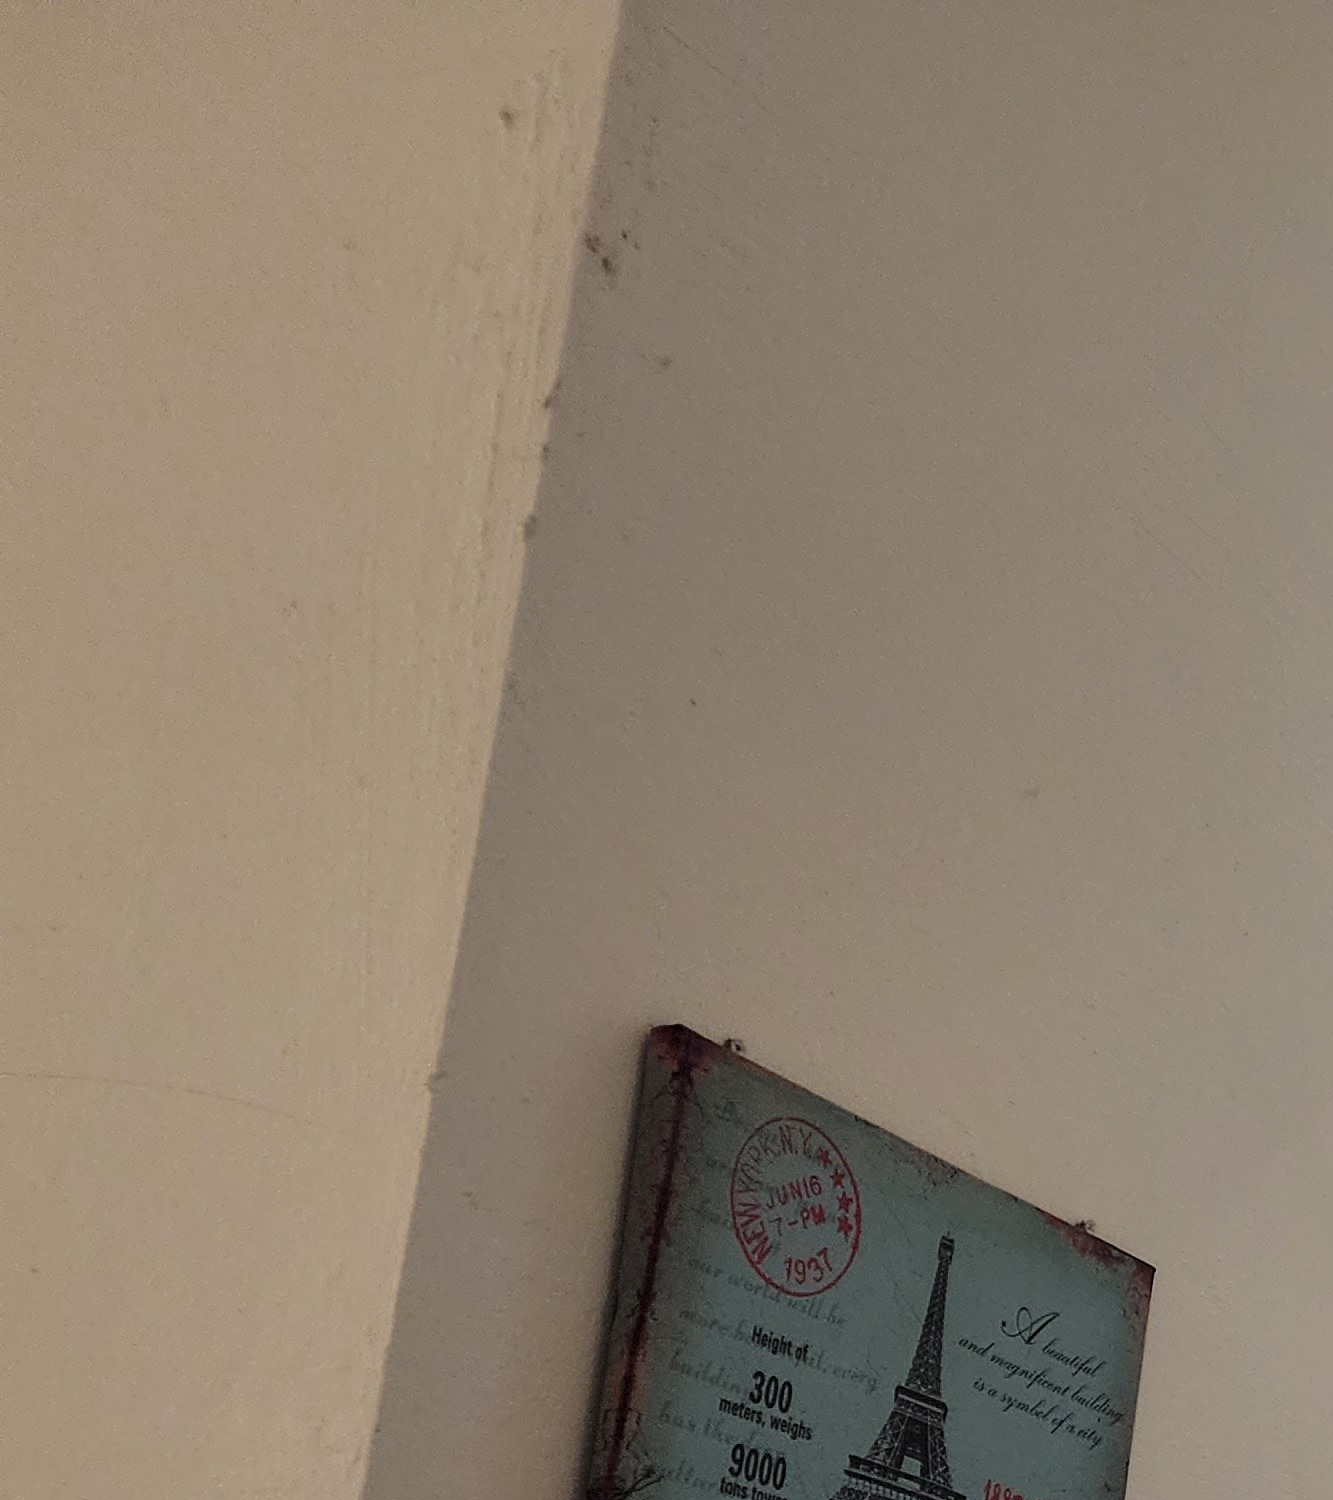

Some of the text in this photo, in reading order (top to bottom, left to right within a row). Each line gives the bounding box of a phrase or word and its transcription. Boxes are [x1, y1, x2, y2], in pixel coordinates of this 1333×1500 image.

[784, 1246, 833, 1286] 1937
[751, 1324, 793, 1355] Height
[794, 1343, 809, 1362] of
[1000, 1306, 1060, 1345] A
[1041, 1338, 1107, 1378] beautiful
[748, 1370, 793, 1414] 300
[958, 1337, 1124, 1427] and magnificent building
[718, 1398, 814, 1441] meters, weighs
[972, 1377, 985, 1393] is
[987, 1388, 998, 1398] a
[1050, 1411, 1075, 1435] of
[1065, 1423, 1076, 1435] a
[1076, 1427, 1103, 1451] city
[727, 1443, 787, 1491] 9000
